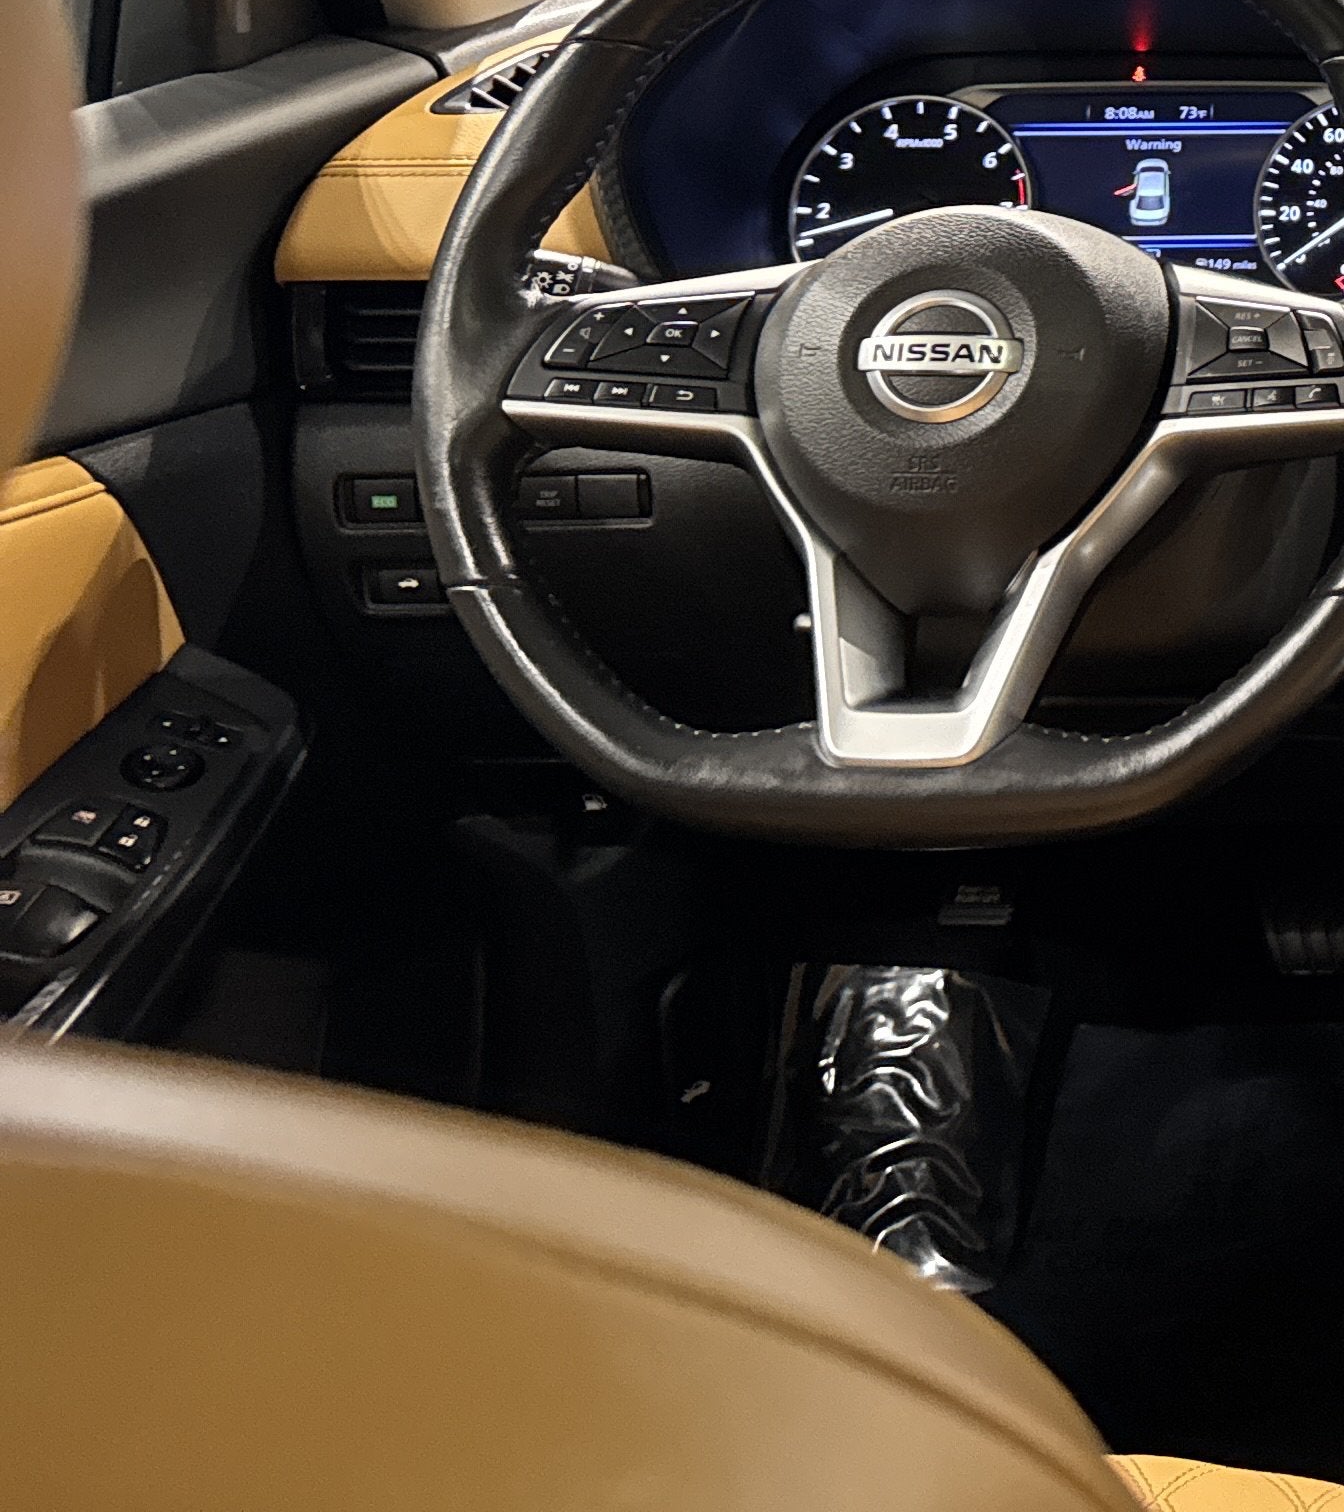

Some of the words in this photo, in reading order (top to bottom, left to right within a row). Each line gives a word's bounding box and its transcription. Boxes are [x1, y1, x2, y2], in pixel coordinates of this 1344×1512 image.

[883, 123, 899, 140] 4
[943, 123, 959, 141] 5
[1125, 138, 1183, 153] Warning
[837, 152, 854, 170] 3
[982, 151, 998, 169] 6
[1290, 158, 1314, 174] 40
[815, 202, 831, 219] 2
[1278, 205, 1301, 221] 20
[1207, 257, 1232, 270] 149
[1233, 311, 1251, 320] RES
[664, 327, 683, 338] OK
[1231, 334, 1263, 343] CANCEL
[871, 342, 1004, 364] NISSAN
[1237, 359, 1253, 368] SET
